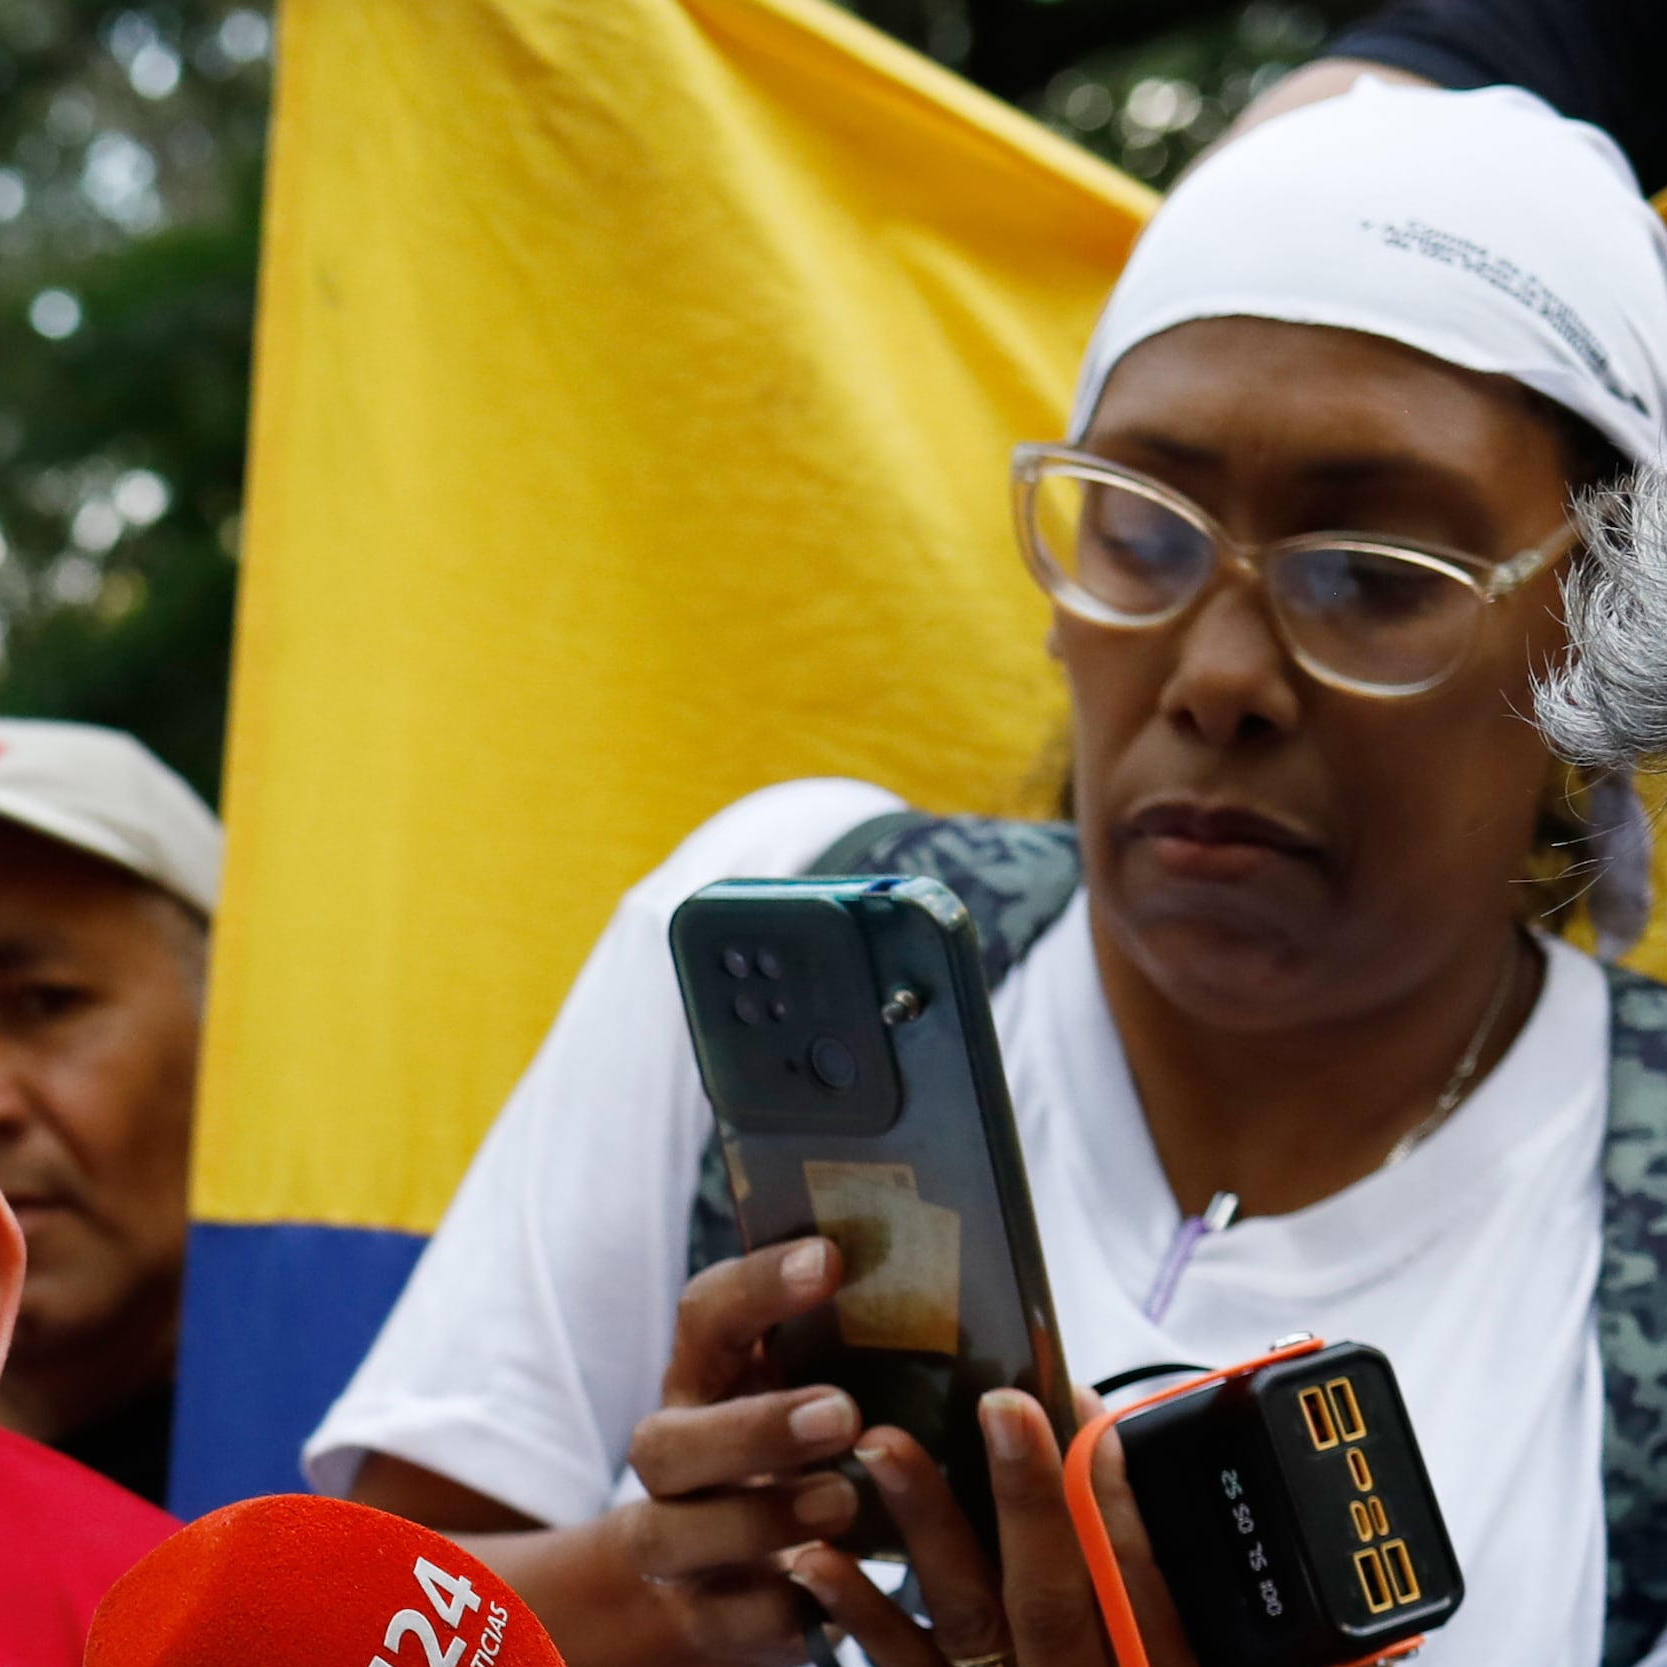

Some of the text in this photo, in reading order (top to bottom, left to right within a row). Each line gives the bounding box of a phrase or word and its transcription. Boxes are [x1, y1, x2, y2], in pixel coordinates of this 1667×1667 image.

[1221, 1469, 1284, 1617] 25 50 75 100
